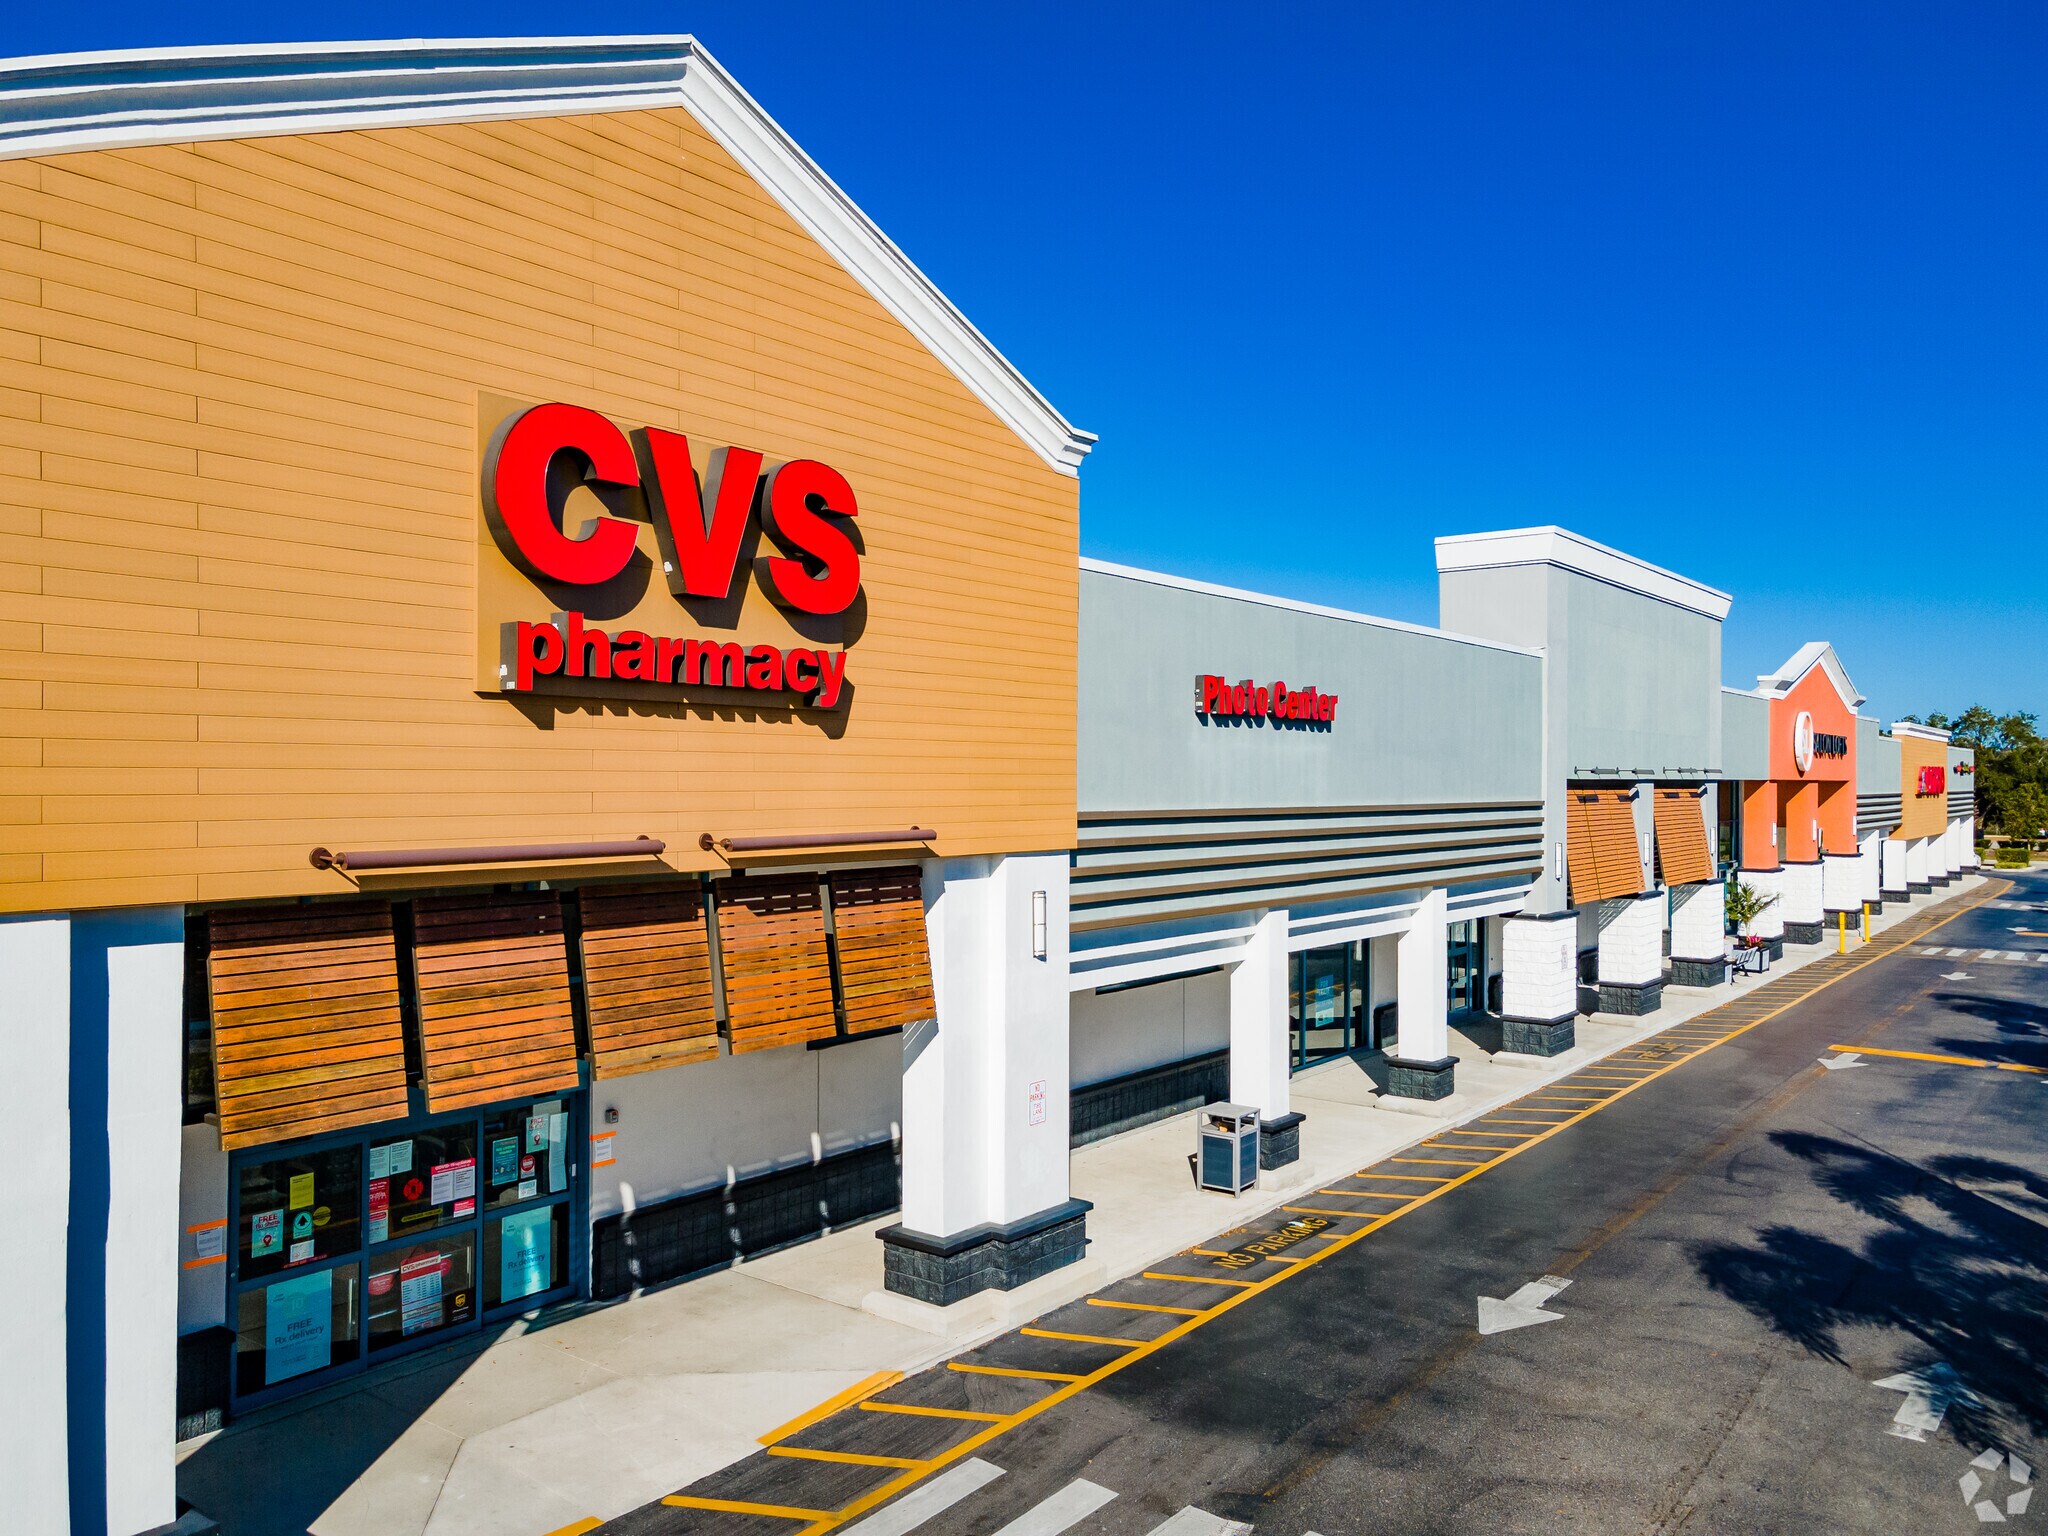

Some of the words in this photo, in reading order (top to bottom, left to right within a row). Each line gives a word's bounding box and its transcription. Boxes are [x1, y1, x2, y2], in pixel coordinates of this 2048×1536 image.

[490, 402, 861, 615] CVS
[510, 610, 847, 707] pharmacy
[1199, 674, 1269, 716] Photo
[1272, 680, 1339, 722] Center
[258, 1213, 278, 1223] FREE
[516, 1247, 537, 1258] FREE
[1213, 1252, 1256, 1270] NO
[1244, 1217, 1328, 1255] PARKING
[402, 1263, 415, 1272] CVS
[274, 1336, 287, 1345] Rx
[288, 1324, 325, 1341] delivery
[287, 1317, 313, 1332] FREE
